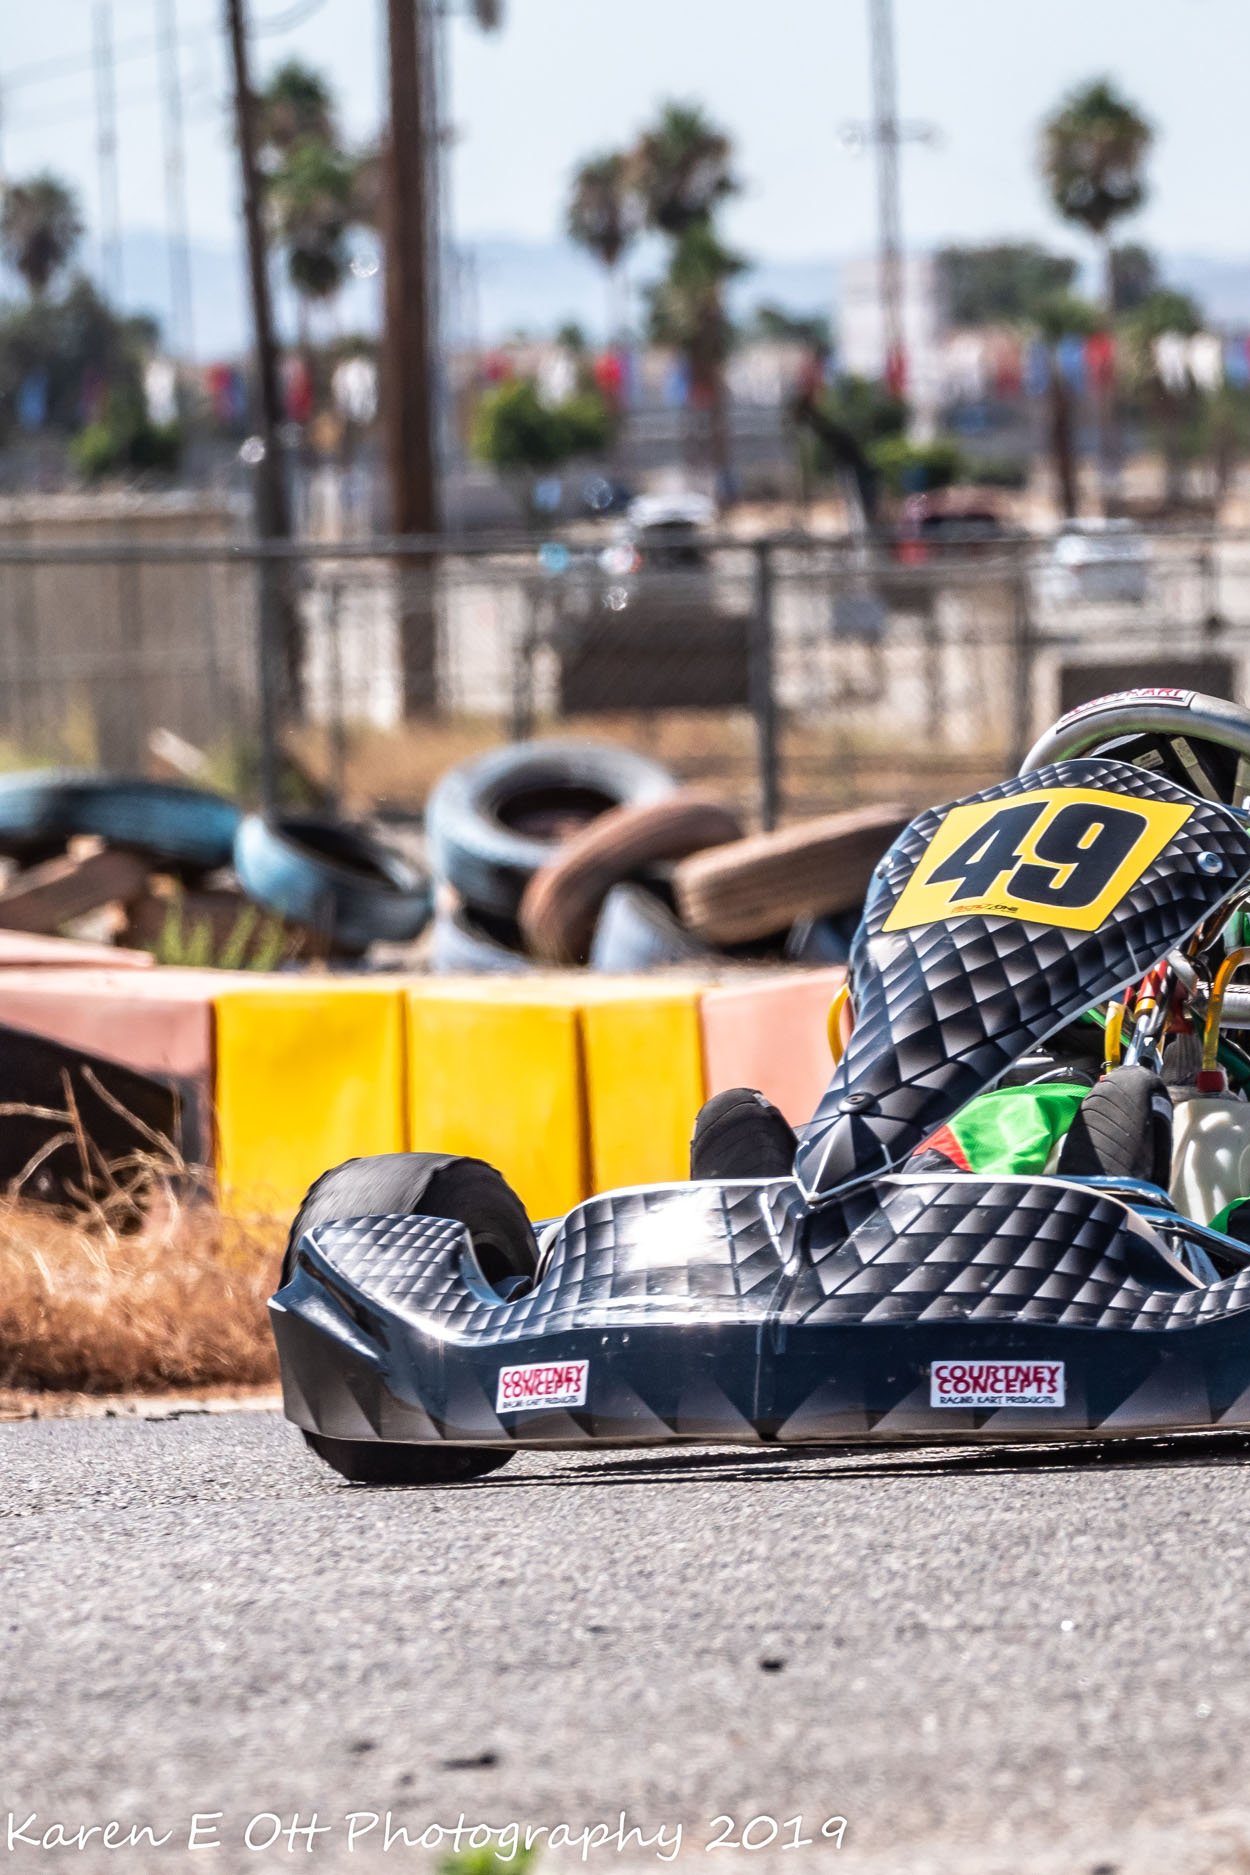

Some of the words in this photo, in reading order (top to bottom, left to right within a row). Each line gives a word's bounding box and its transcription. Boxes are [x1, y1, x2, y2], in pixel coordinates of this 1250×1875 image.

[925, 801, 1149, 908] 49
[502, 1365, 585, 1386] COURTNEY
[935, 1365, 1060, 1383] COURTNEY
[503, 1380, 581, 1399] CONCEPTS
[938, 1379, 1058, 1394] CONCEPTS
